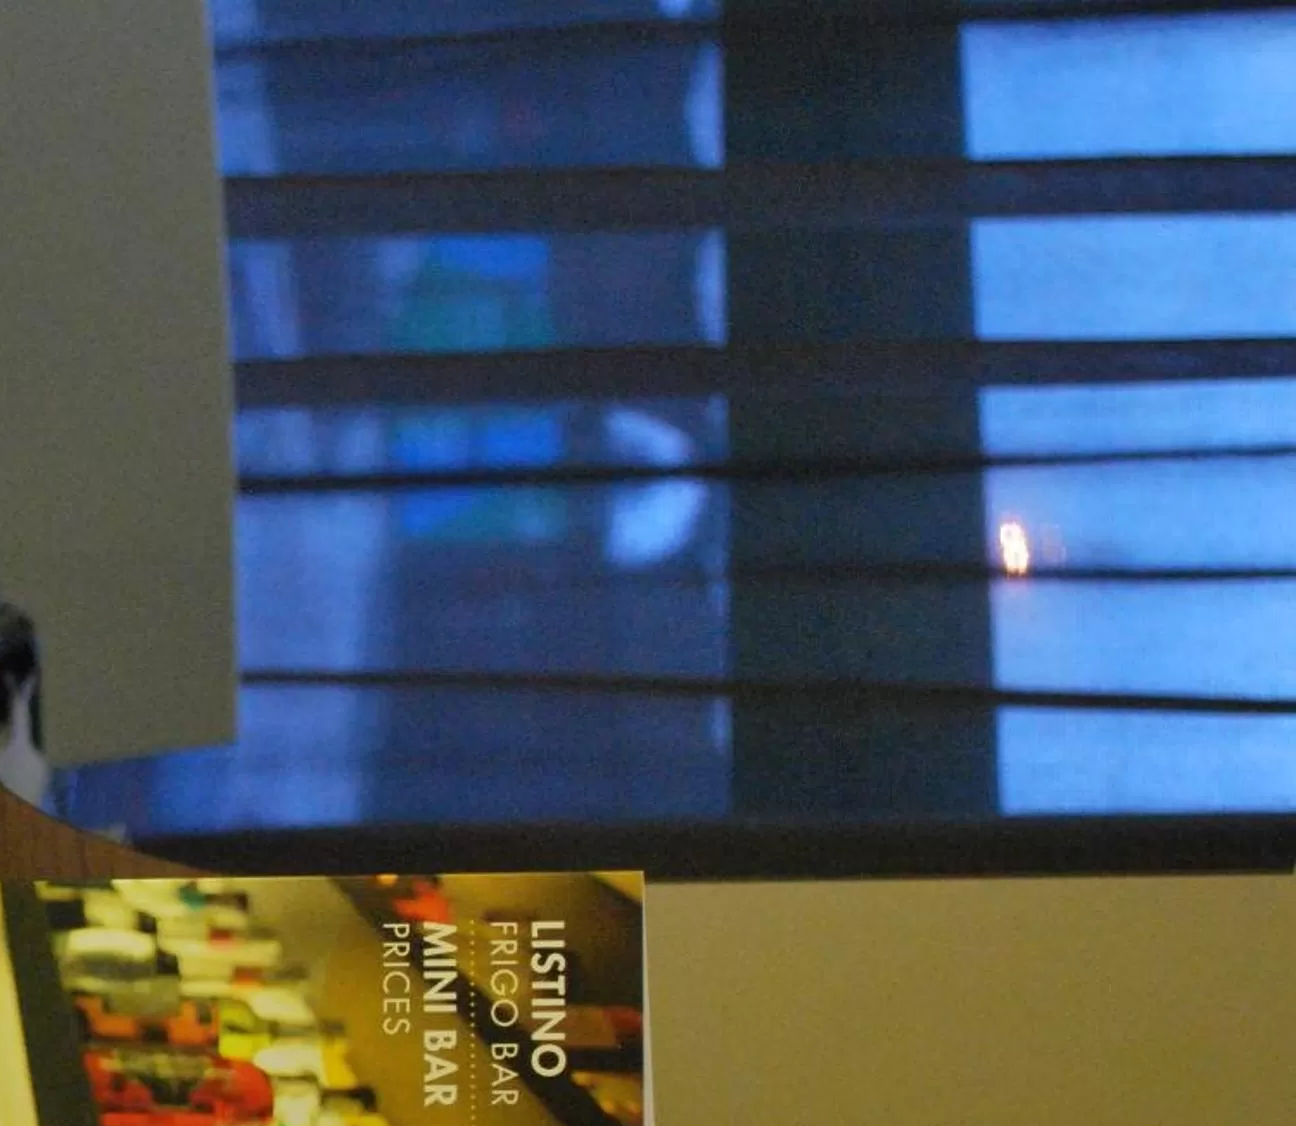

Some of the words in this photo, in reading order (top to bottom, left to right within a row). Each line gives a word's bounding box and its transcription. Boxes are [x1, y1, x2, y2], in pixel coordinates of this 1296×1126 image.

[382, 922, 411, 1036] PRICES
[422, 920, 458, 1014] MINI
[489, 921, 519, 1028] FRIGO
[530, 920, 567, 1078] LISTINO
[423, 1029, 459, 1107] BAR
[490, 1043, 520, 1106] BAR
